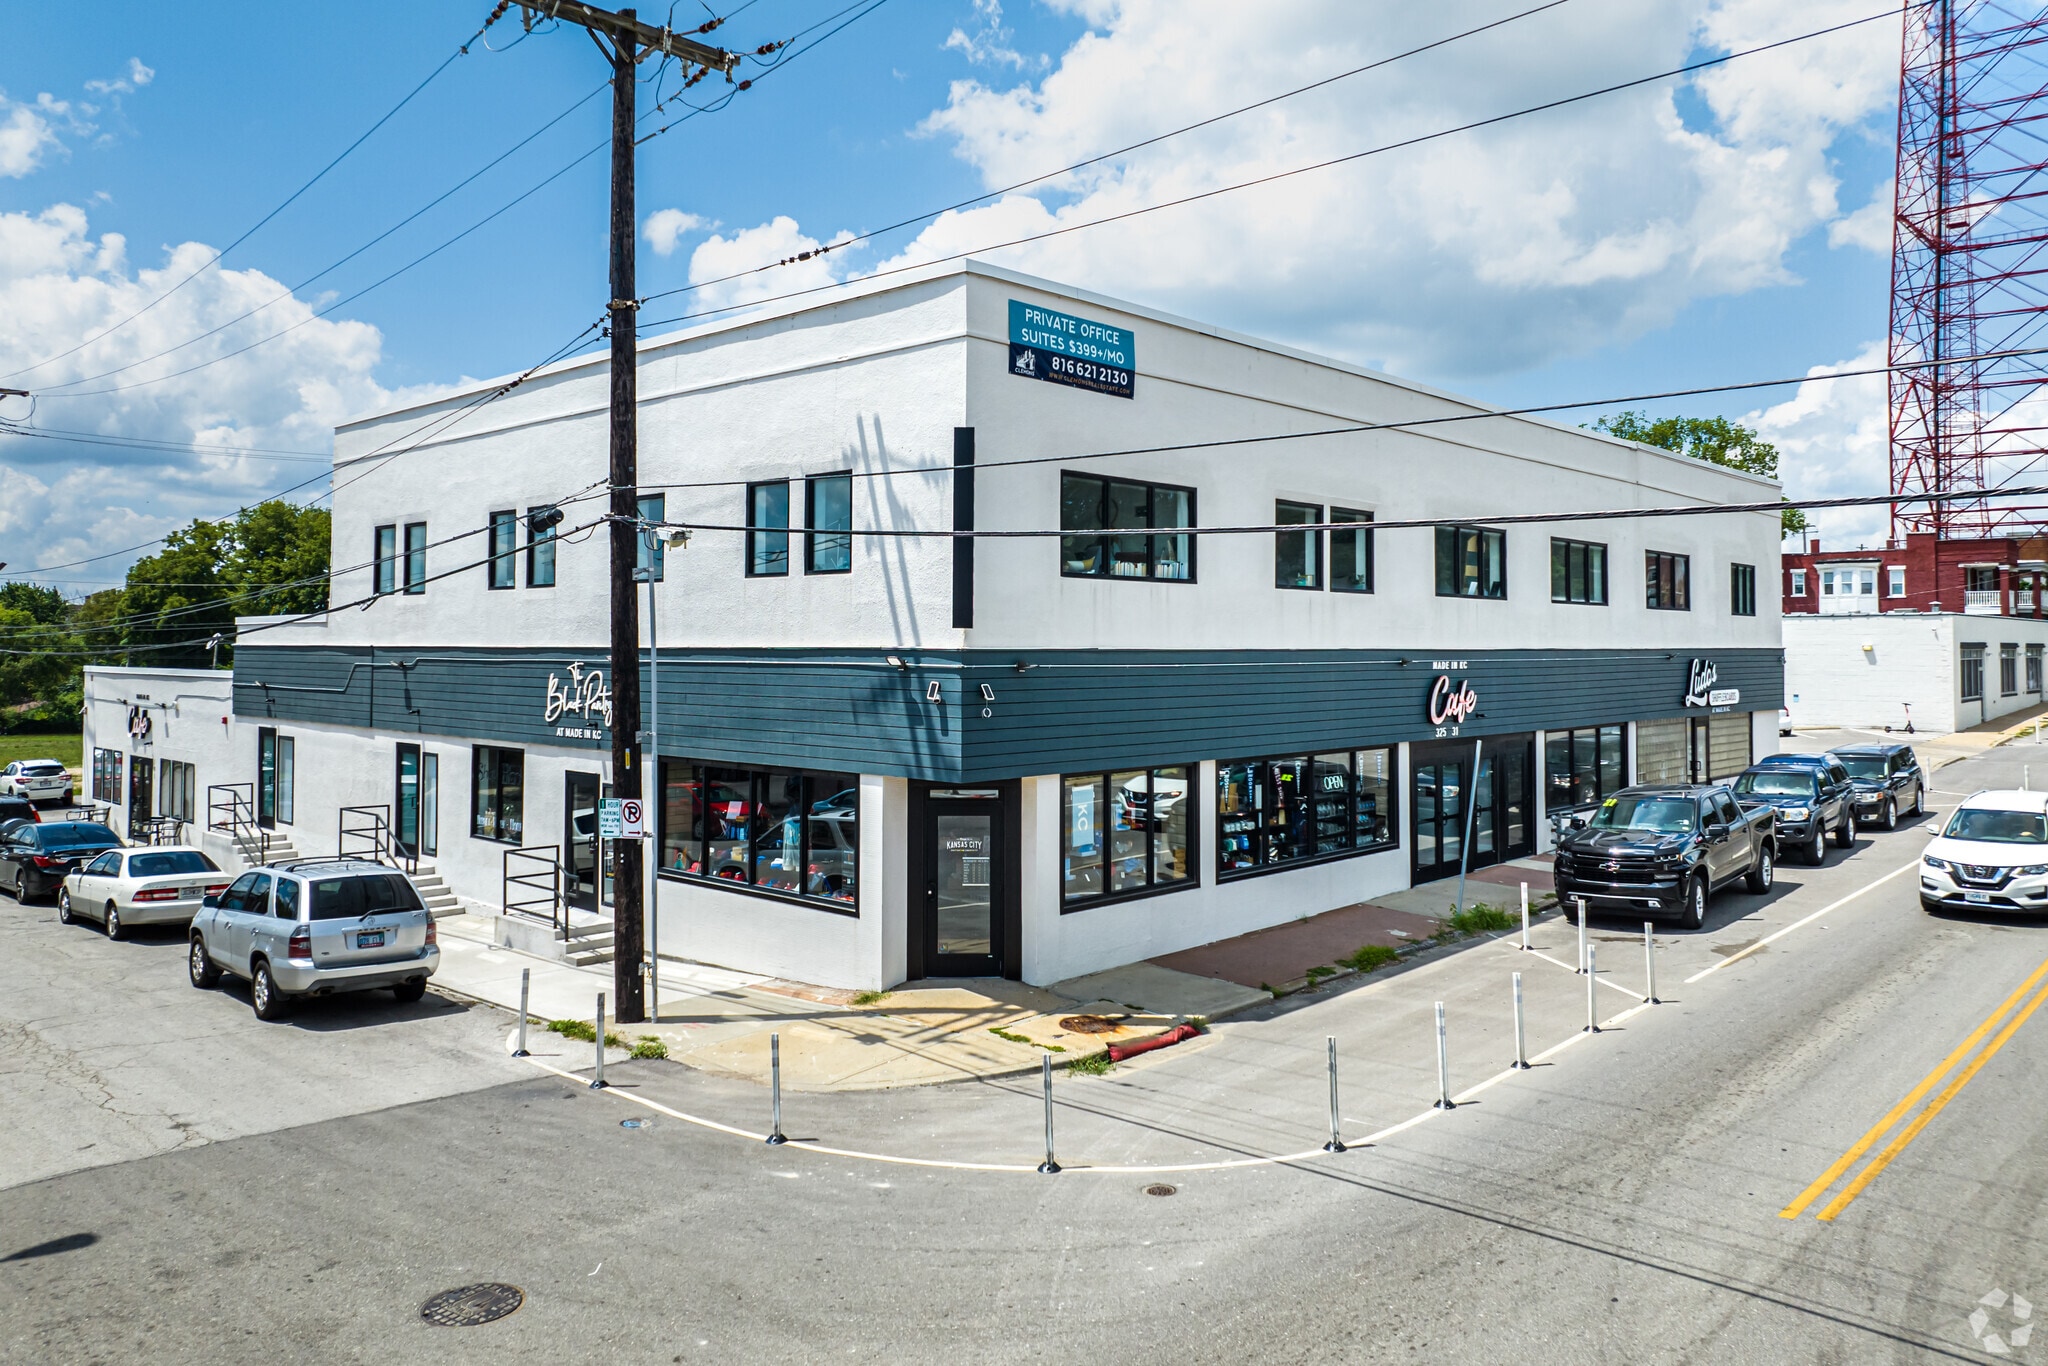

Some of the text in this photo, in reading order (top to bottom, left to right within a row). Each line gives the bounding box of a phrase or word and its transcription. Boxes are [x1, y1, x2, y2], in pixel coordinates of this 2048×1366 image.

[1025, 308, 1120, 345] PRIVATE OFFICE
[1022, 328, 1124, 364] SUITES $399+/MO
[1014, 368, 1035, 376] CLEMONS
[1432, 661, 1468, 670] MADE IN KC
[1686, 658, 1717, 707] Ludo's
[545, 672, 583, 722] Black
[1430, 675, 1477, 725] Cafe
[556, 728, 602, 739] AT MADE IN KC
[1435, 727, 1447, 737] 325
[1324, 775, 1344, 790] OPEN
[1078, 804, 1088, 830] KC
[946, 841, 982, 850] KANSAS CITY
